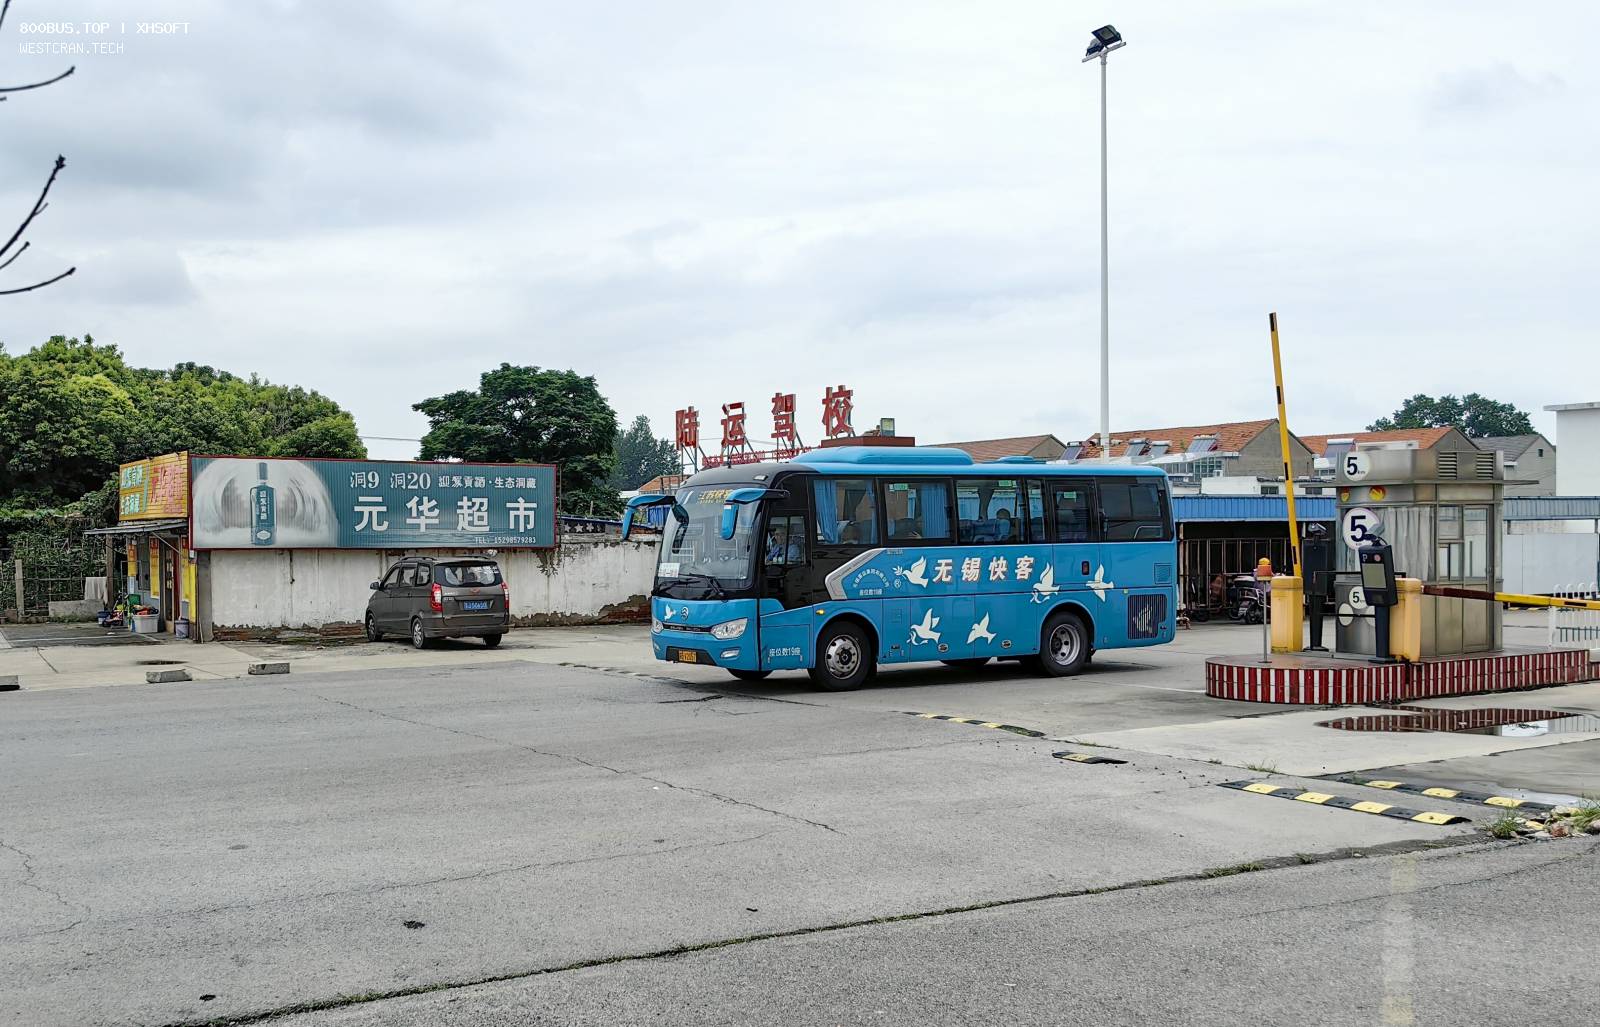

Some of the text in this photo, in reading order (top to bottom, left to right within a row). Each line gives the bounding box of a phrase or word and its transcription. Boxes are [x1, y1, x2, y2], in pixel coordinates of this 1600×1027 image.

[675, 384, 854, 450] 陆运驾校
[1346, 456, 1358, 476] 5
[350, 471, 380, 489] 洞9
[390, 472, 431, 490] 洞20
[354, 495, 538, 533] 元华超市
[1350, 515, 1367, 542] 5
[932, 555, 1035, 583] 无锡快客
[1352, 591, 1360, 603] 5
